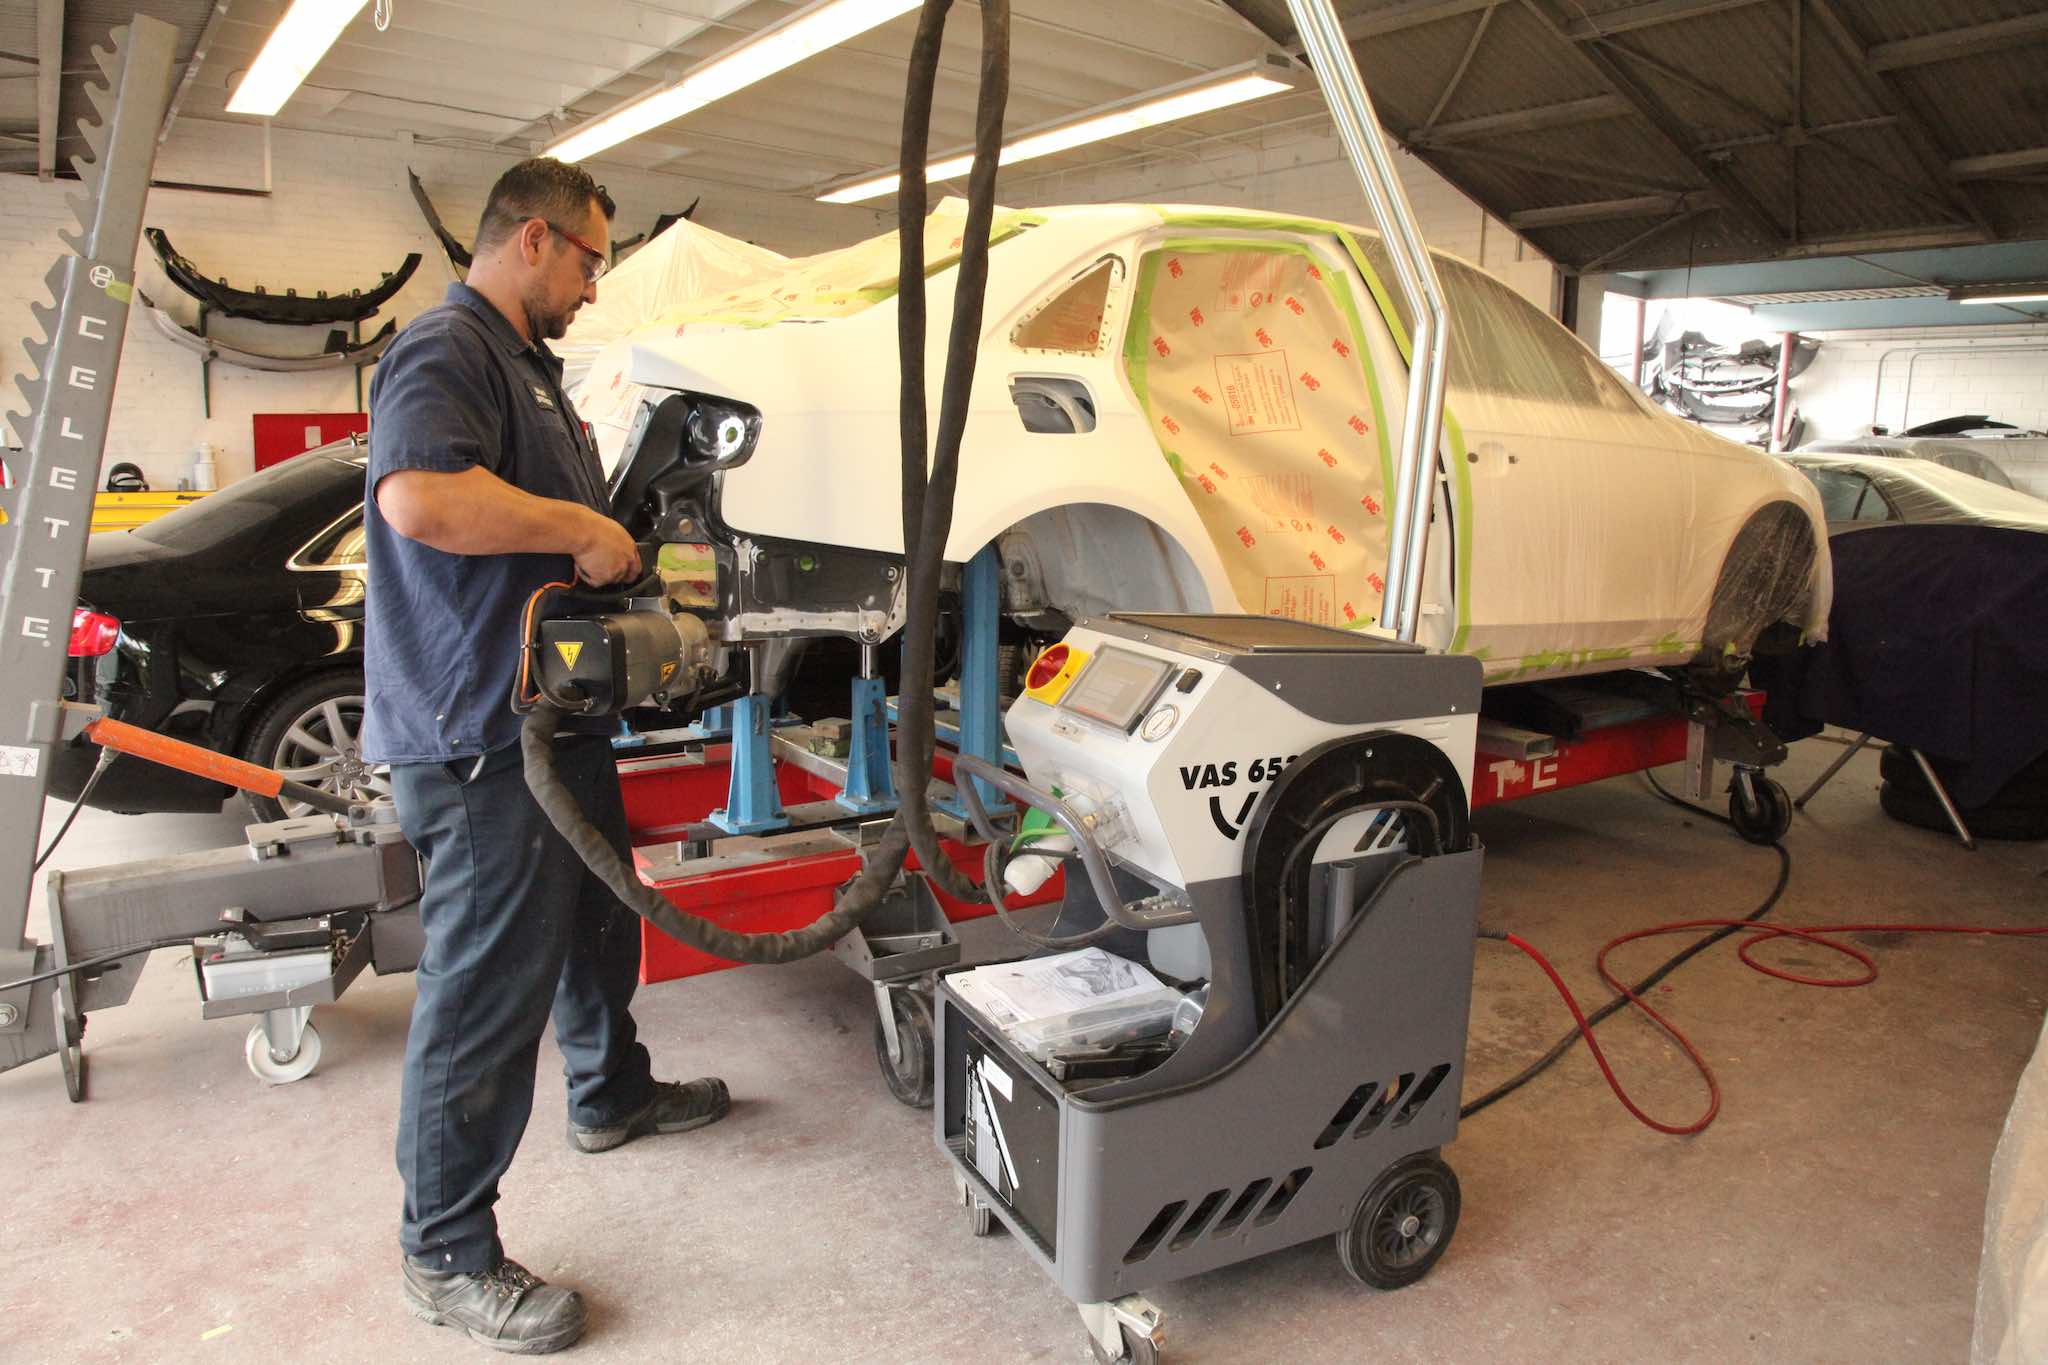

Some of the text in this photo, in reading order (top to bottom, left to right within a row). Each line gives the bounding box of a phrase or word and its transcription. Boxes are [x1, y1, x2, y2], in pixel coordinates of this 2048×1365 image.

[1301, 372, 1321, 391] 3M
[1193, 386, 1213, 404] 3M
[1161, 416, 1180, 435] 3M
[1348, 415, 1369, 436] 3M
[1318, 448, 1338, 468] 3M
[22, 315, 107, 639] CELETTE
[1180, 755, 1299, 791] VAS 65
